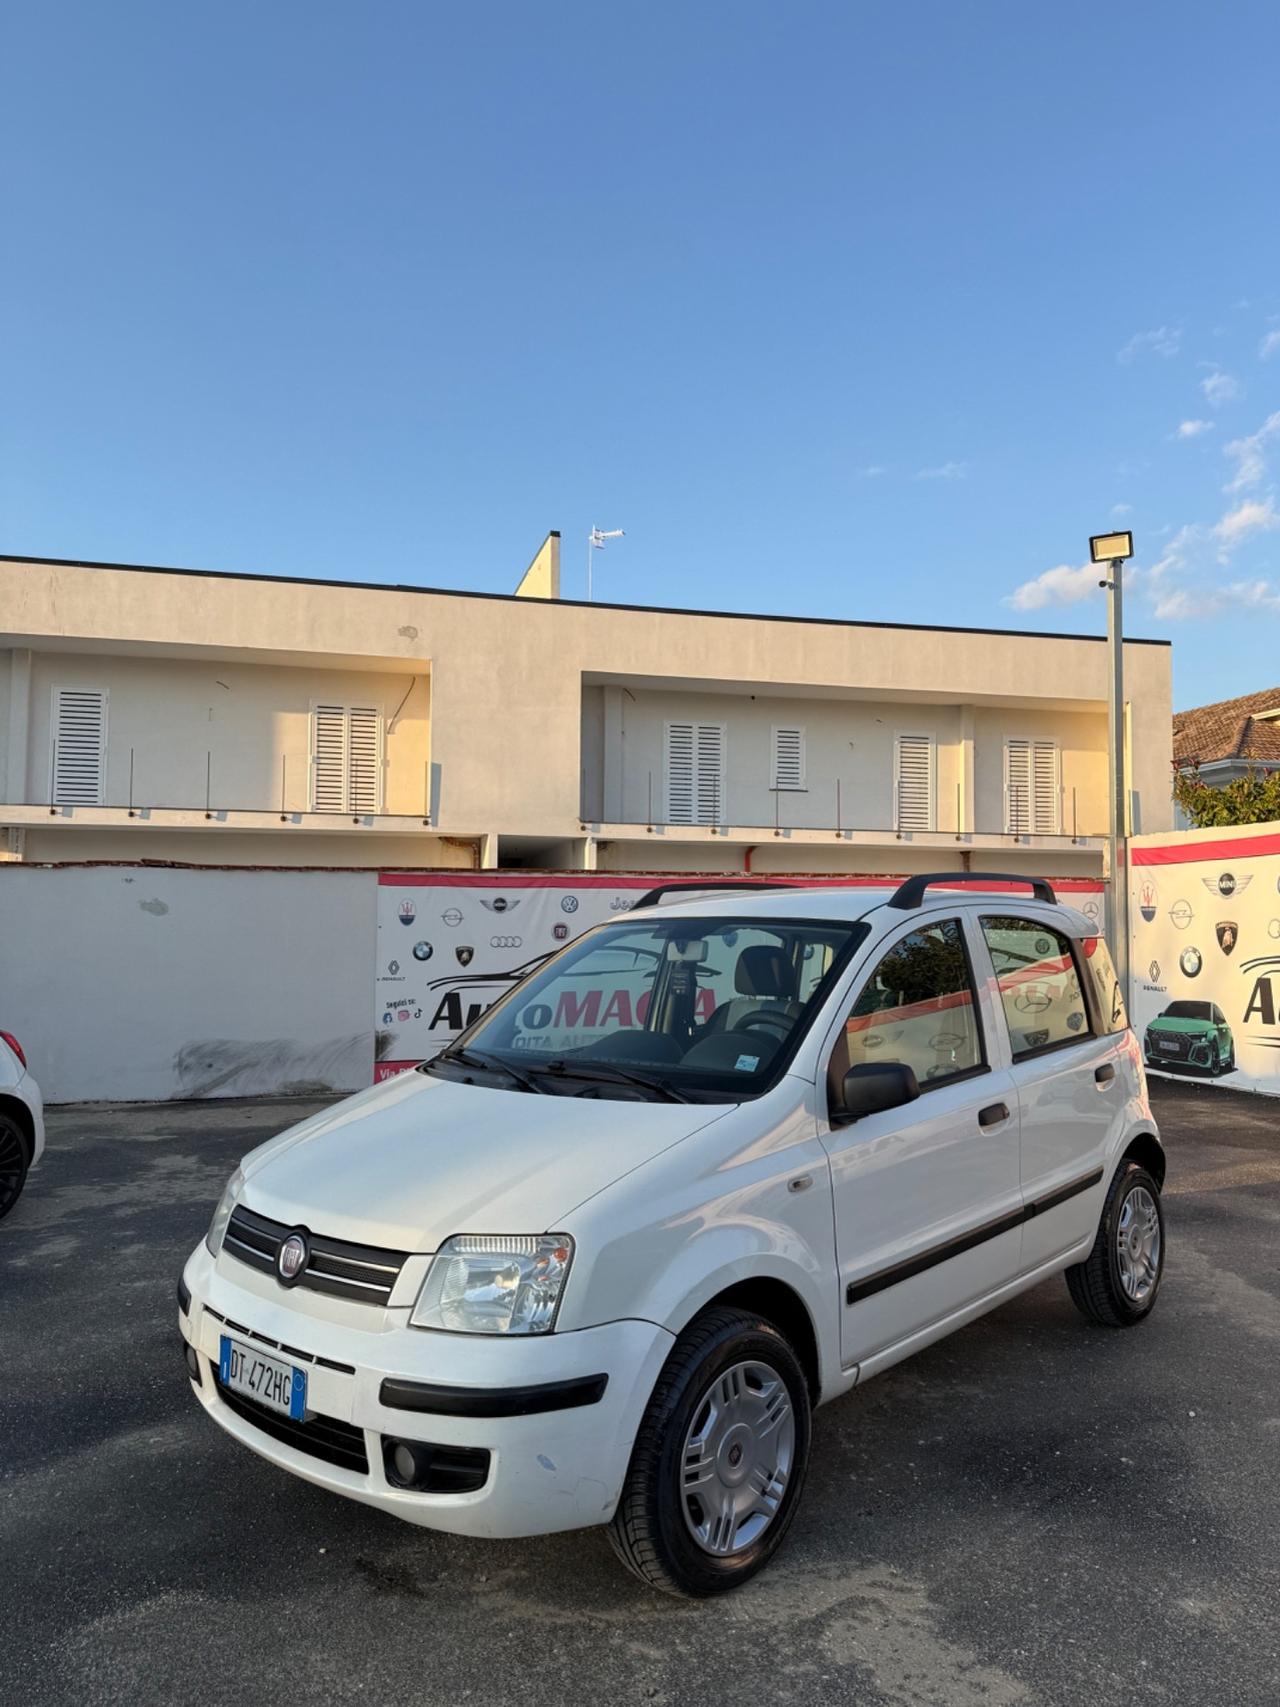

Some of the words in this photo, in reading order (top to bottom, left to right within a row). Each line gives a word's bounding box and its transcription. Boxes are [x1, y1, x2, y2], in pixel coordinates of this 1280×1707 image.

[1243, 977, 1280, 1025] A
[231, 1349, 246, 1383] DT
[248, 1361, 291, 1406] 472HG
